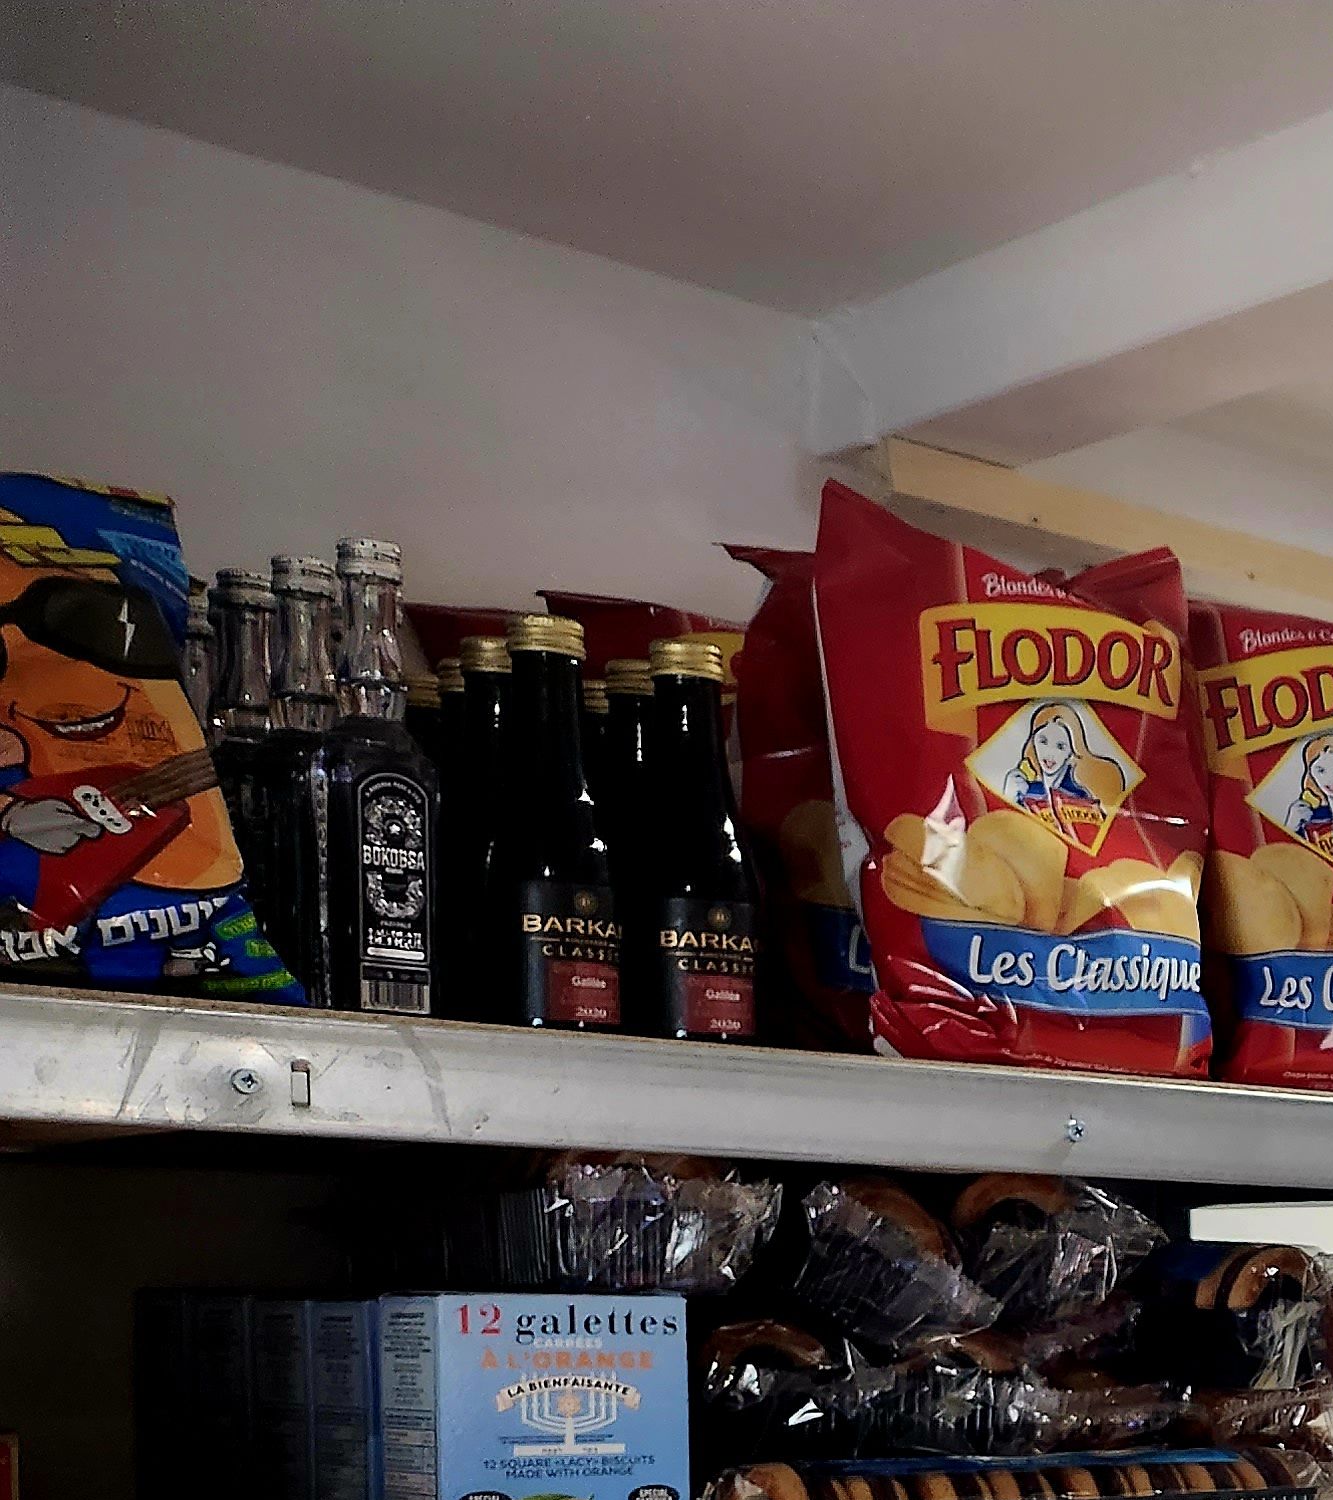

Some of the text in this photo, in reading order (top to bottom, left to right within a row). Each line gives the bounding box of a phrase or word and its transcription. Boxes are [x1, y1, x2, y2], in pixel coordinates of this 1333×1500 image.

[932, 618, 1173, 706] FLODOR
[363, 845, 425, 871] BOKOBSA
[0, 925, 81, 962] אפו
[969, 935, 1200, 1001] Les Classique
[1260, 966, 1312, 1010] Les
[457, 1303, 678, 1345] 12 galettes
[507, 1351, 655, 1370] L'ORANGE
[507, 1377, 630, 1398] LA BIENFAISANTE
